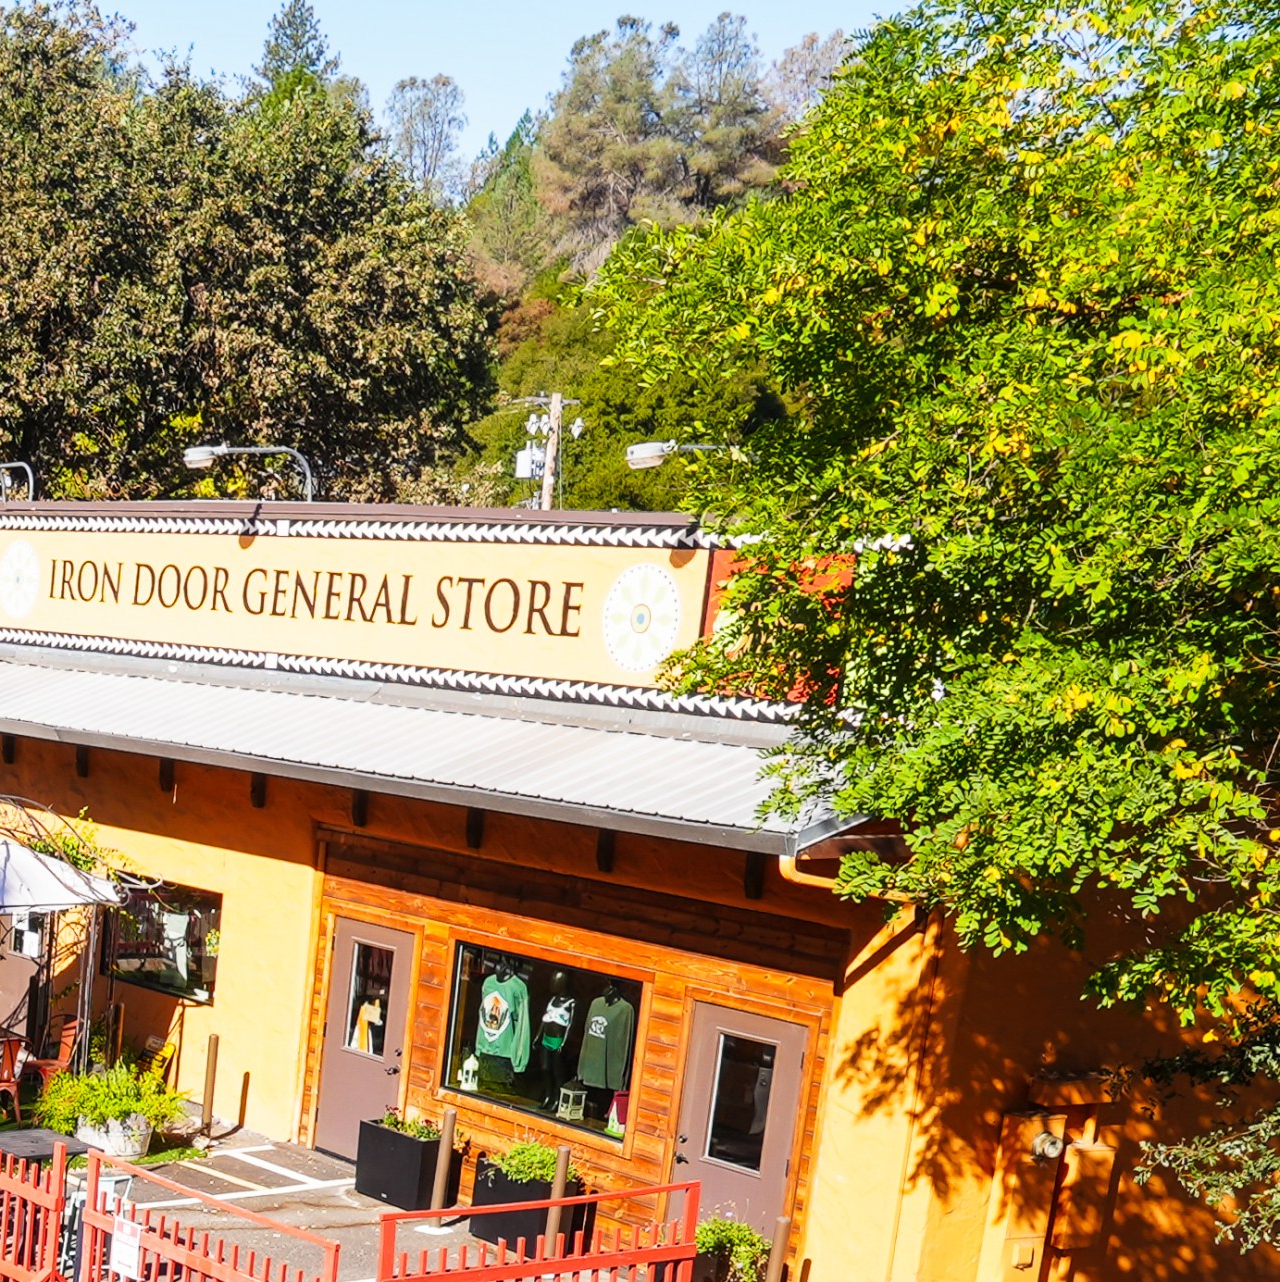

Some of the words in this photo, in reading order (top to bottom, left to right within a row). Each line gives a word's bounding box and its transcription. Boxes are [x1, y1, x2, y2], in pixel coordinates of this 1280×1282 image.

[48, 557, 122, 605] IRON
[133, 562, 232, 614] DOOR
[242, 568, 417, 626] GENERAL
[430, 576, 584, 638] STORE
